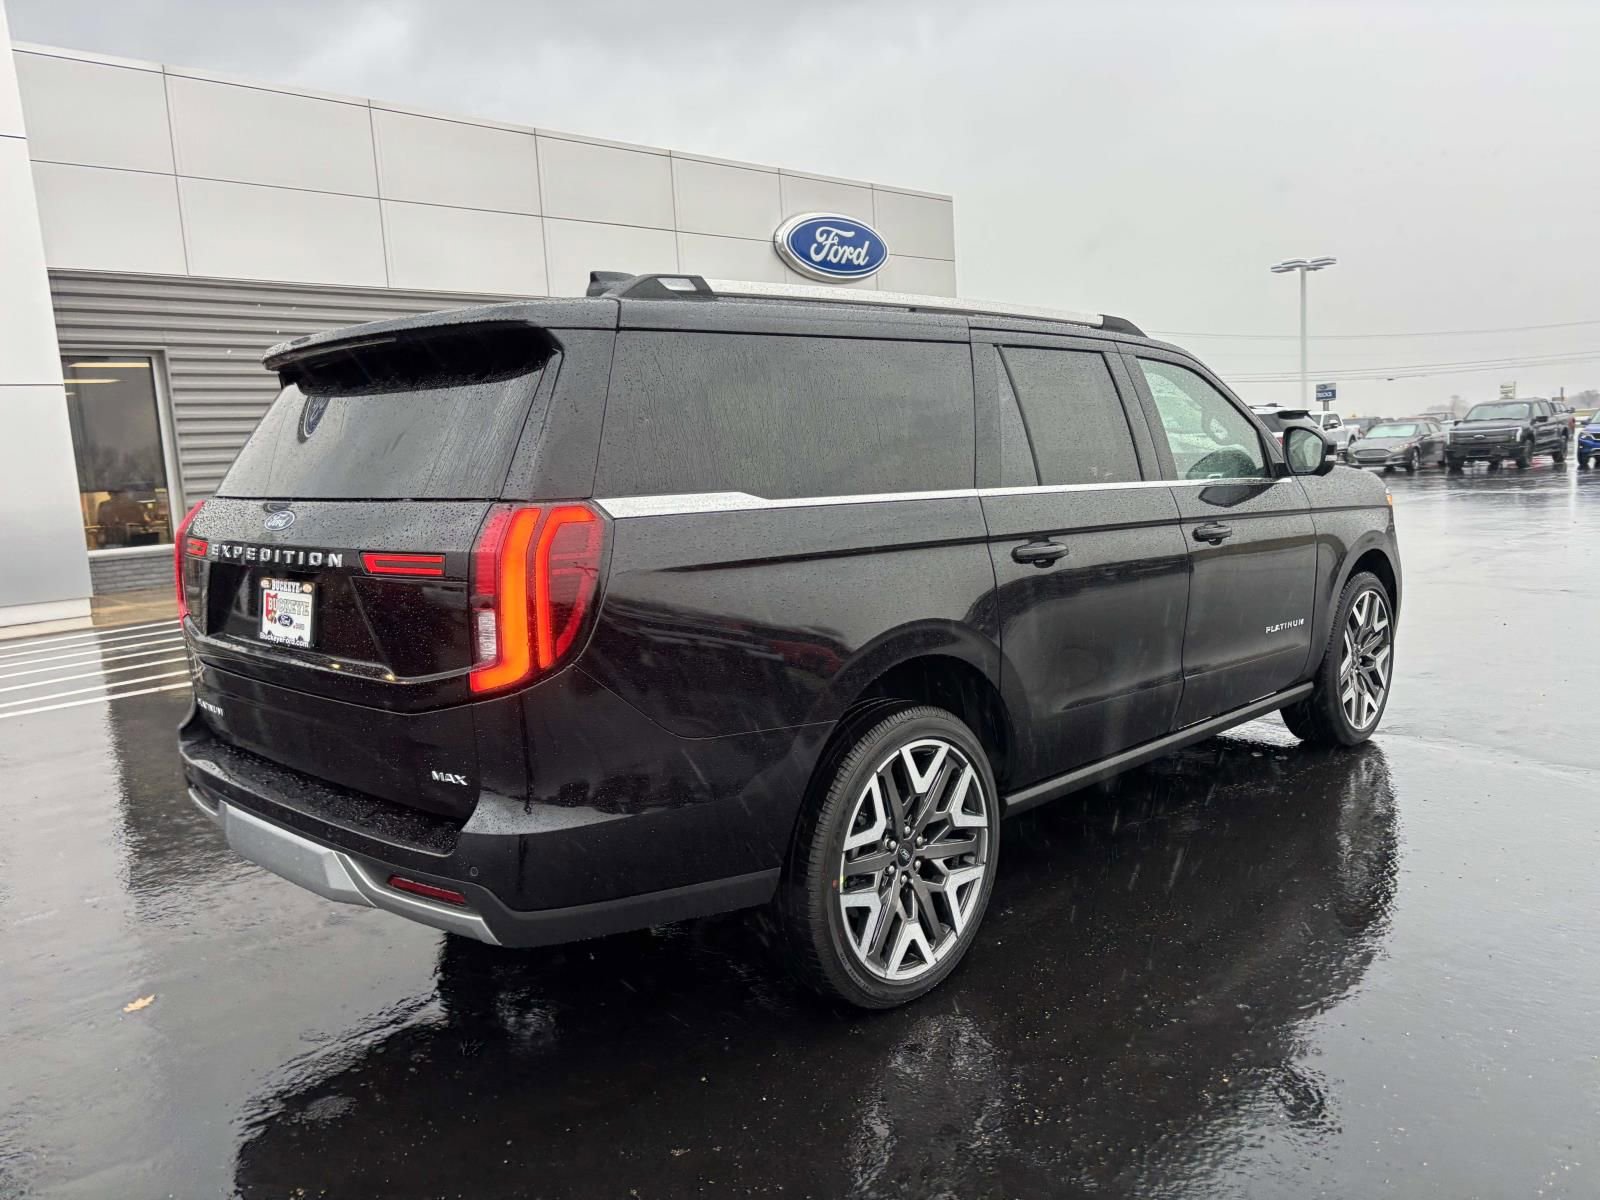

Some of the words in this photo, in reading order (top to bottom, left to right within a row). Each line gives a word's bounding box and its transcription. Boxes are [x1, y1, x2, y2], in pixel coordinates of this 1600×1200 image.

[810, 226, 870, 265] Ford
[211, 543, 343, 568] EXPEDITION
[271, 580, 301, 593] BUCKEYE
[269, 598, 310, 616] BUCKEYE
[1265, 618, 1304, 634] PLATINUM
[259, 632, 309, 648] BuckeyeFord.com
[431, 770, 468, 786] MAX
